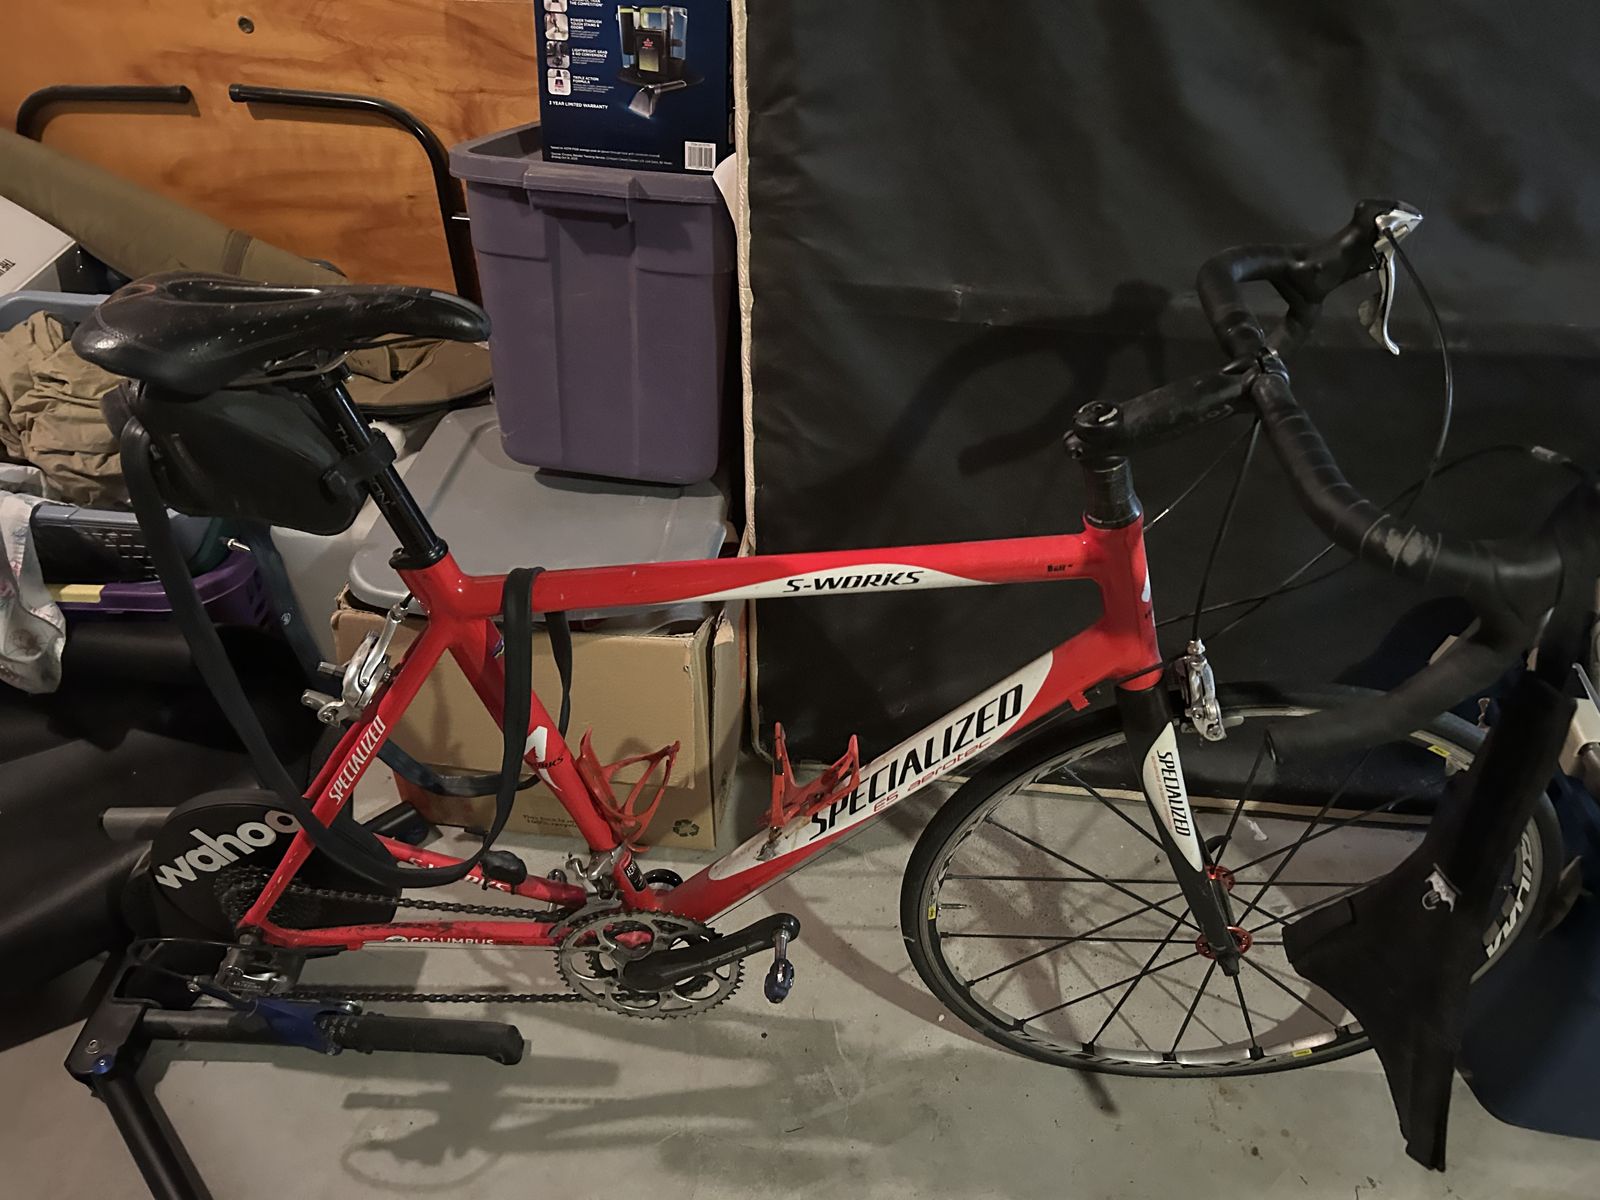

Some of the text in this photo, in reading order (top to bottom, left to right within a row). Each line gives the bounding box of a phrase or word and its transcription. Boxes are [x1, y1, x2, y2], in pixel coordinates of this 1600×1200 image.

[782, 570, 925, 593] S-WORKS
[328, 714, 386, 805] SPECIALIZED
[809, 684, 1023, 841] SPECIALIZED
[873, 737, 991, 812] E5 aerotec
[1156, 750, 1191, 836] SPECIALIZED
[154, 810, 304, 889] wahoo
